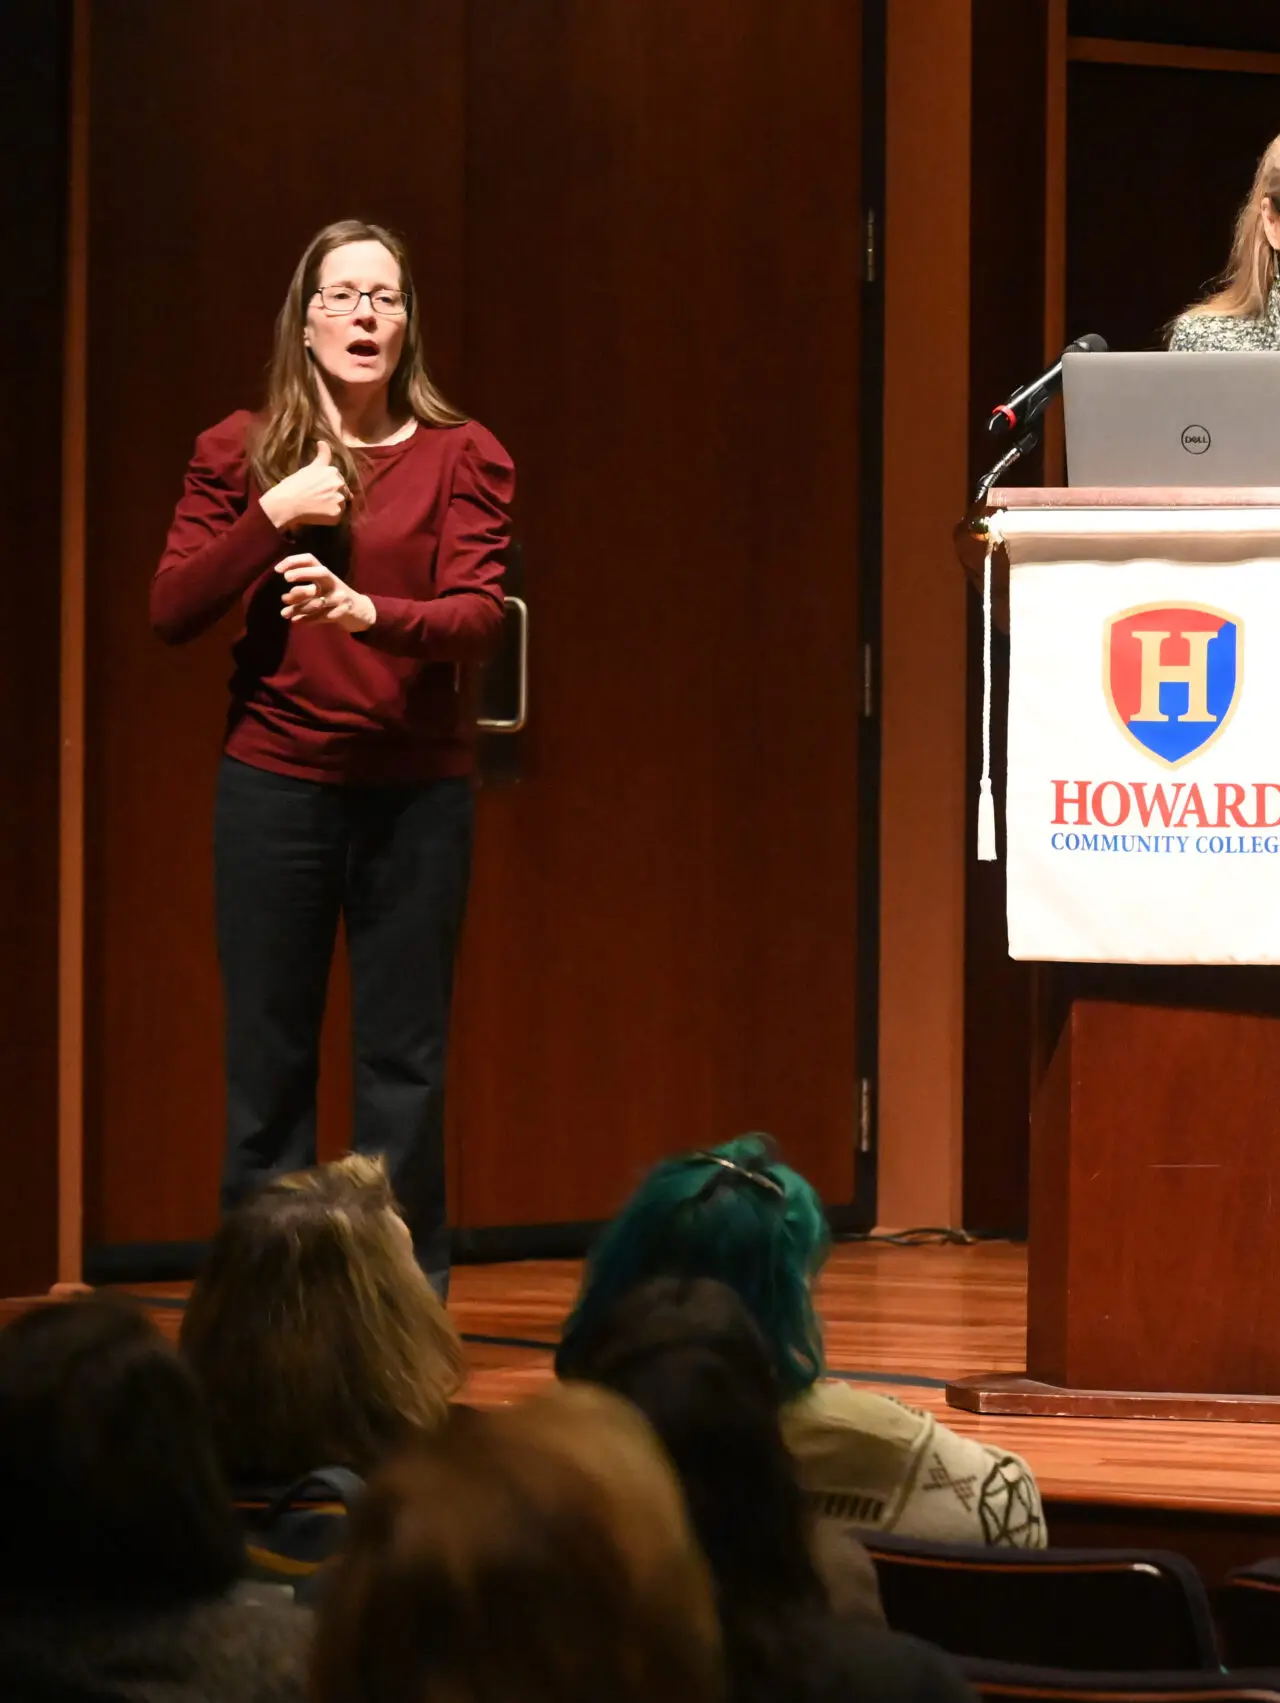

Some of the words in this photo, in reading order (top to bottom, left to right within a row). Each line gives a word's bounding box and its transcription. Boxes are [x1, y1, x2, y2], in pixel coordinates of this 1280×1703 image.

[1184, 435, 1208, 444] DELL
[1130, 631, 1218, 722] H
[1051, 832, 1190, 854] COMMUNITY
